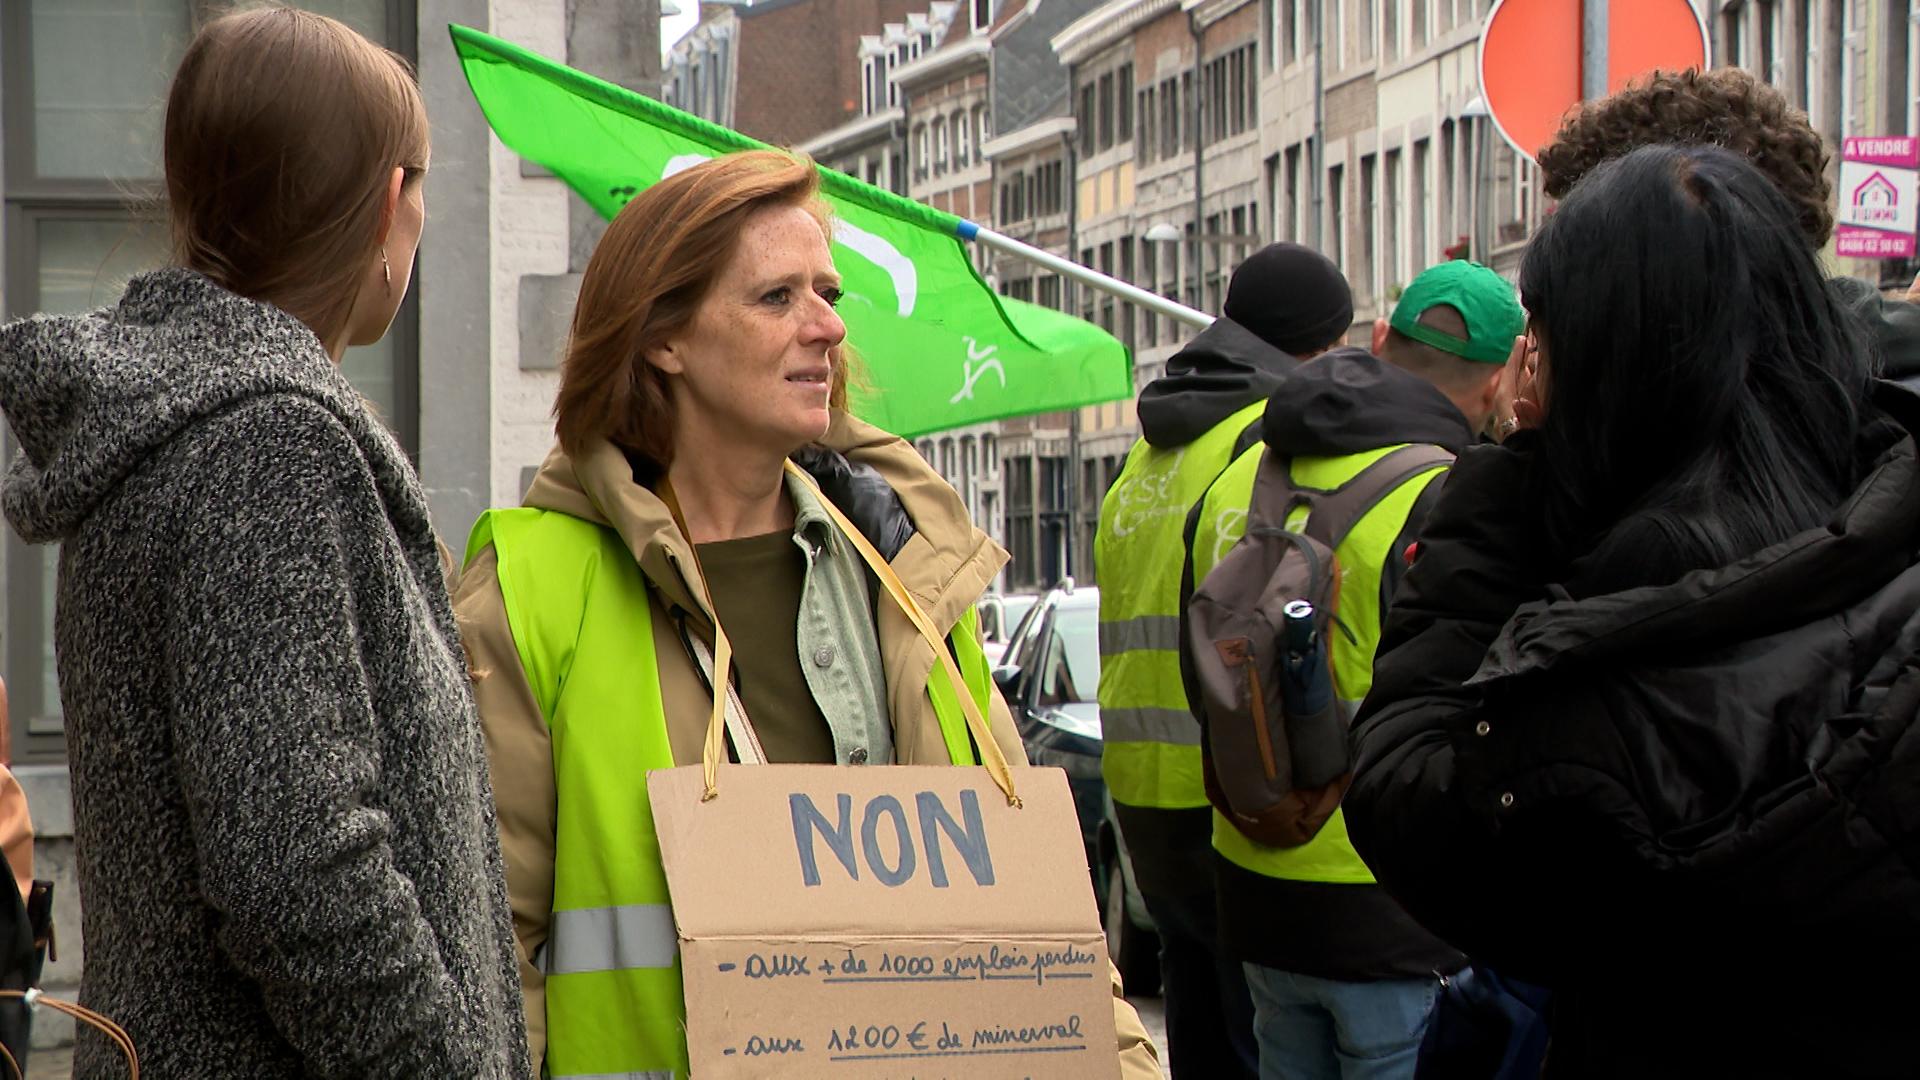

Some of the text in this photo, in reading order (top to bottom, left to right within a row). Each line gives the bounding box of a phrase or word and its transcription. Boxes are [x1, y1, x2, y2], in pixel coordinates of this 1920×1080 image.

[1844, 140, 1911, 157] A VENDRE
[788, 789, 996, 888] NON
[744, 953, 811, 979] aux
[818, 959, 836, 976] +
[841, 949, 868, 974] de
[879, 953, 934, 976] 1000
[942, 945, 1028, 980] emplois
[1031, 944, 1096, 986] perdus
[744, 1035, 805, 1056] aux
[827, 1024, 900, 1052] 1200
[937, 1021, 963, 1050] de
[972, 1015, 1084, 1048] minerval
